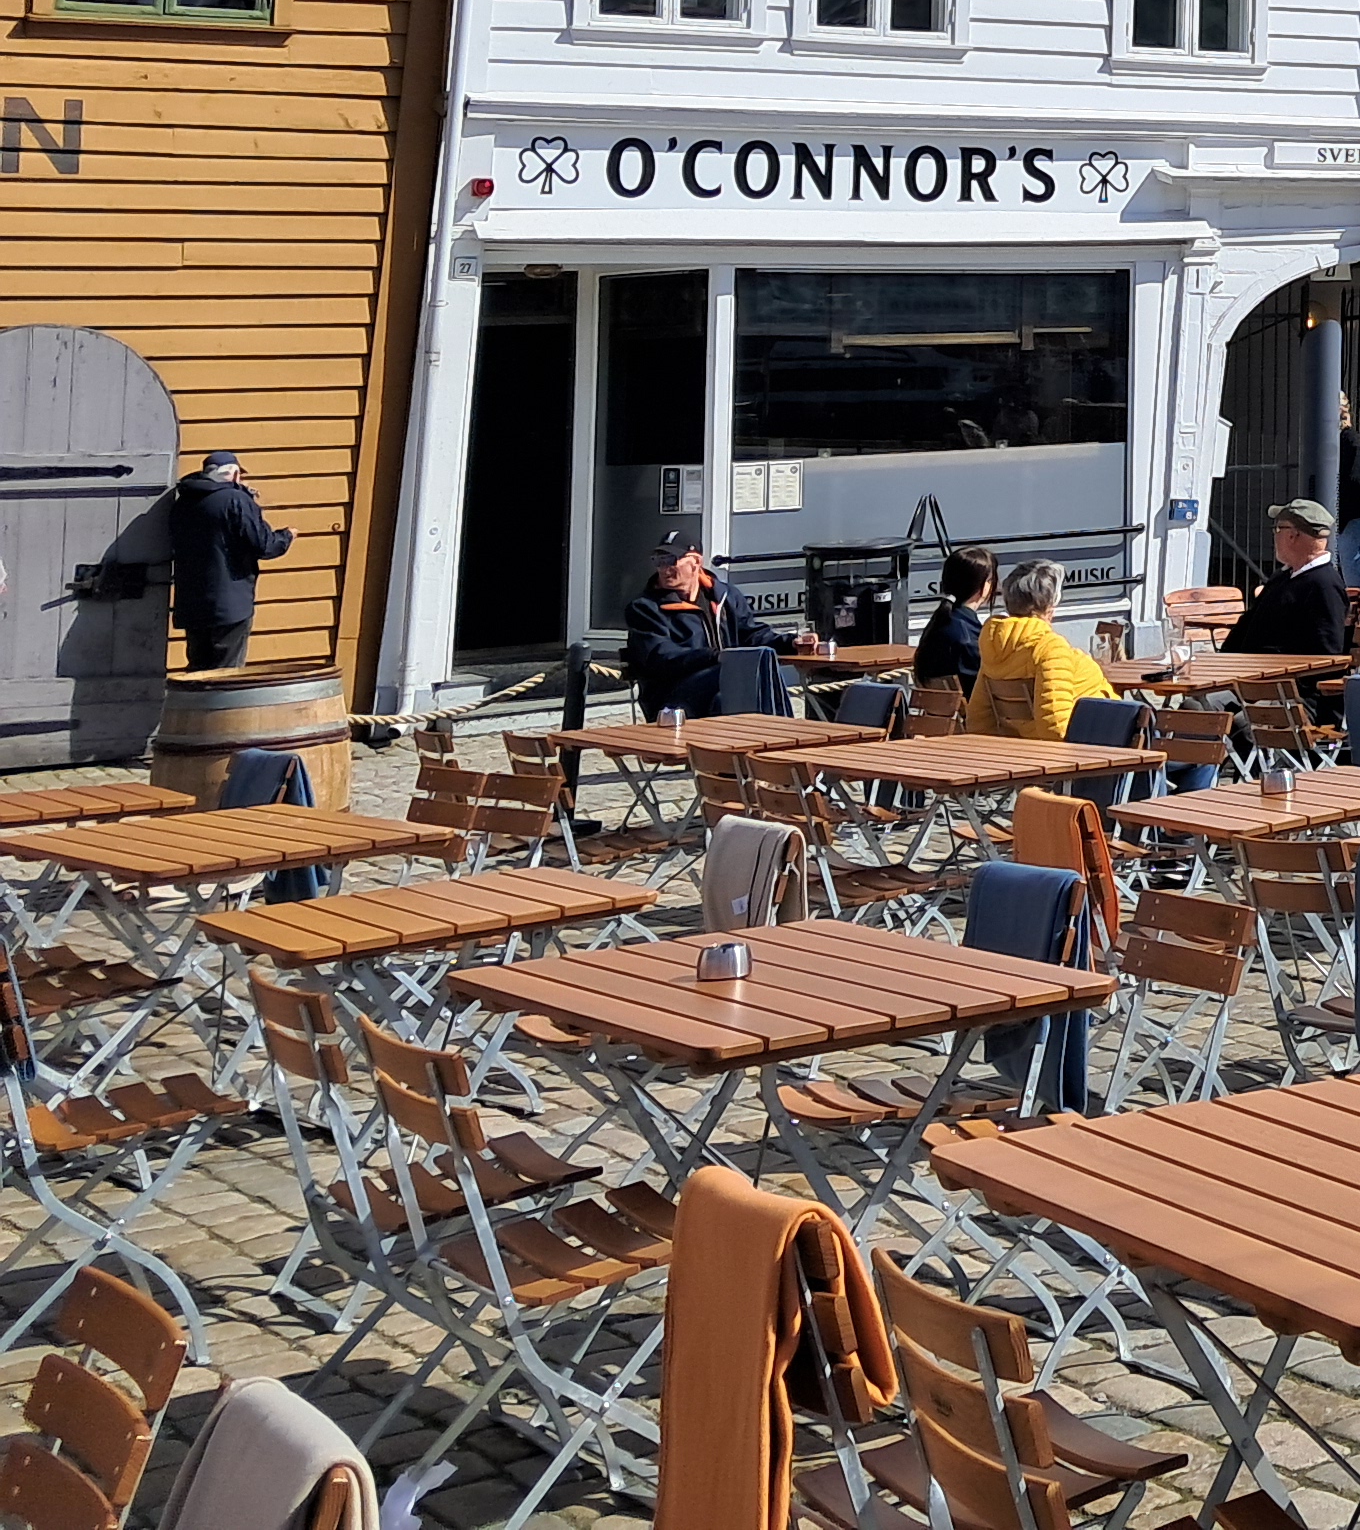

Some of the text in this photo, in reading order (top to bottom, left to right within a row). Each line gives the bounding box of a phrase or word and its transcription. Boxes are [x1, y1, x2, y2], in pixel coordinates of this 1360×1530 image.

[1, 96, 84, 175] N
[604, 135, 1057, 205] O'CONNOR'S
[458, 262, 472, 275] 27
